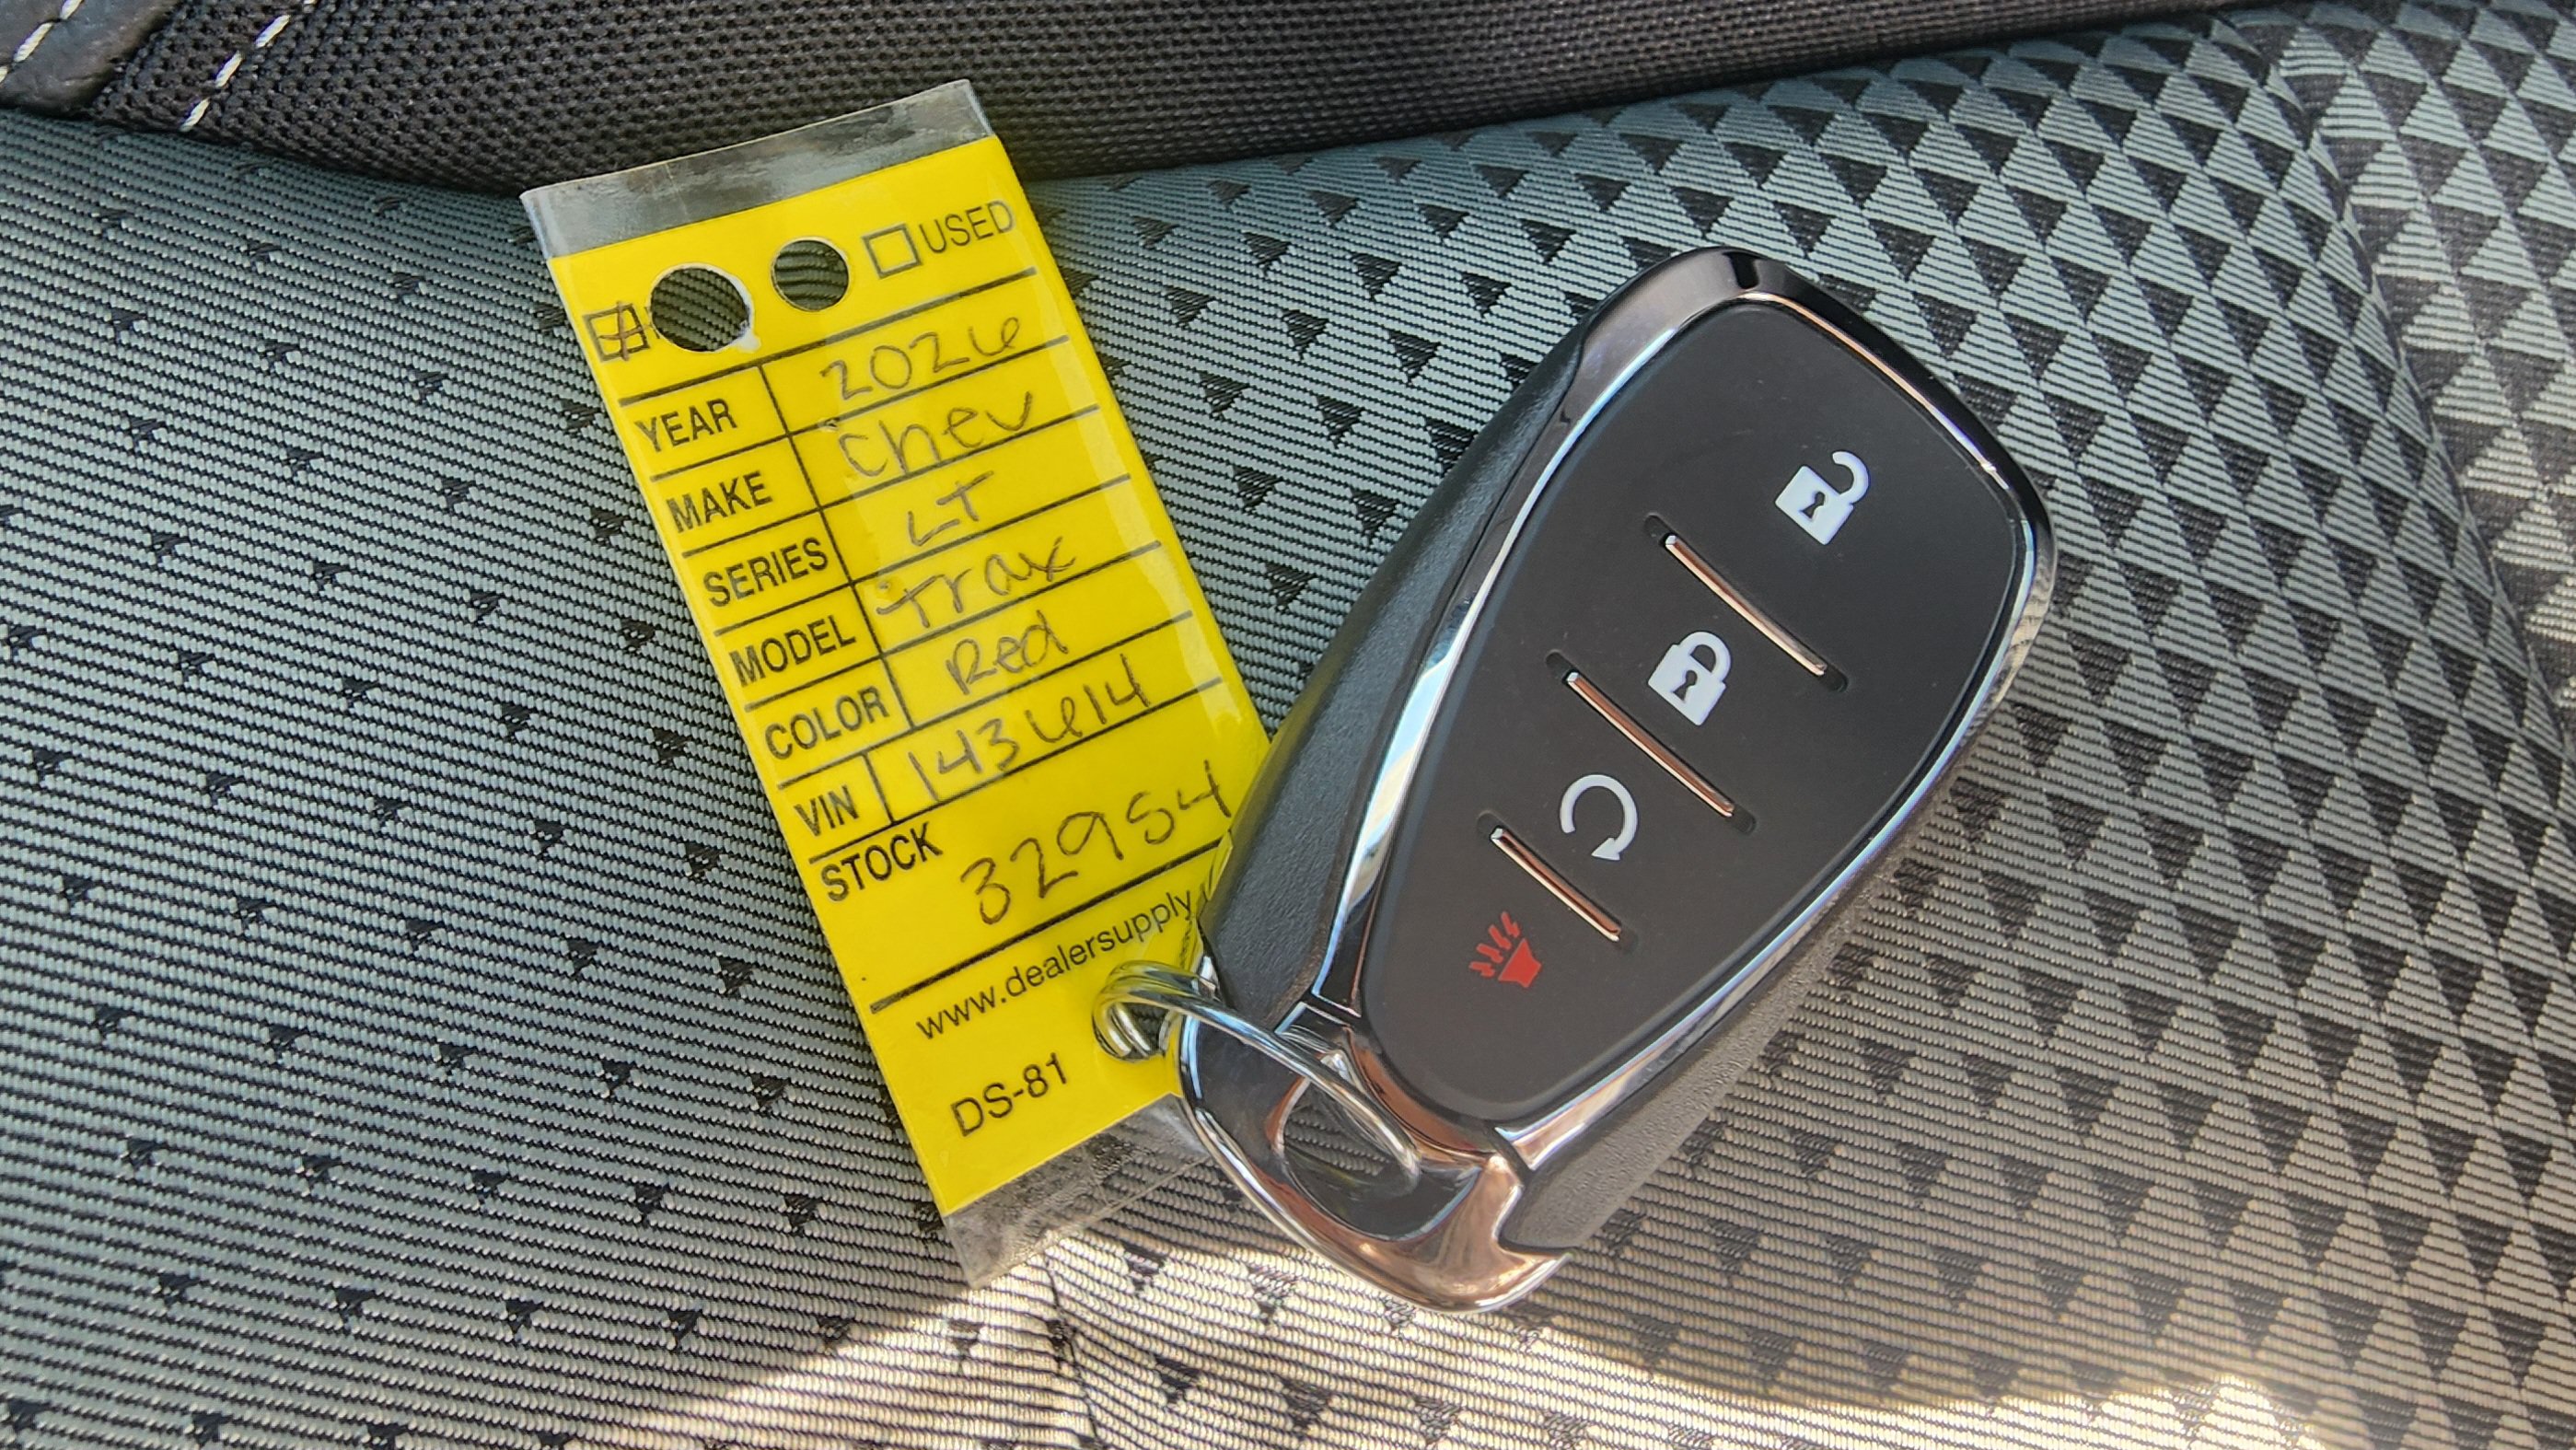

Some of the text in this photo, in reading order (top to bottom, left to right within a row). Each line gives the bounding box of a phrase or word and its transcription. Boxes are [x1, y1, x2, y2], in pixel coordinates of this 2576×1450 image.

[921, 200, 1014, 253] USED
[634, 397, 737, 453] YEAR
[666, 470, 772, 533] MAKE
[905, 471, 993, 547] LT
[702, 536, 829, 609] SERIES
[729, 614, 856, 688] MODEL
[944, 609, 1069, 695] Red
[764, 684, 889, 760] COLOR
[906, 652, 1151, 801] 143614
[794, 783, 861, 837] VIN
[959, 760, 1232, 925] 32954
[820, 821, 944, 902] STOCK
[950, 1051, 1068, 1138] DS-81
